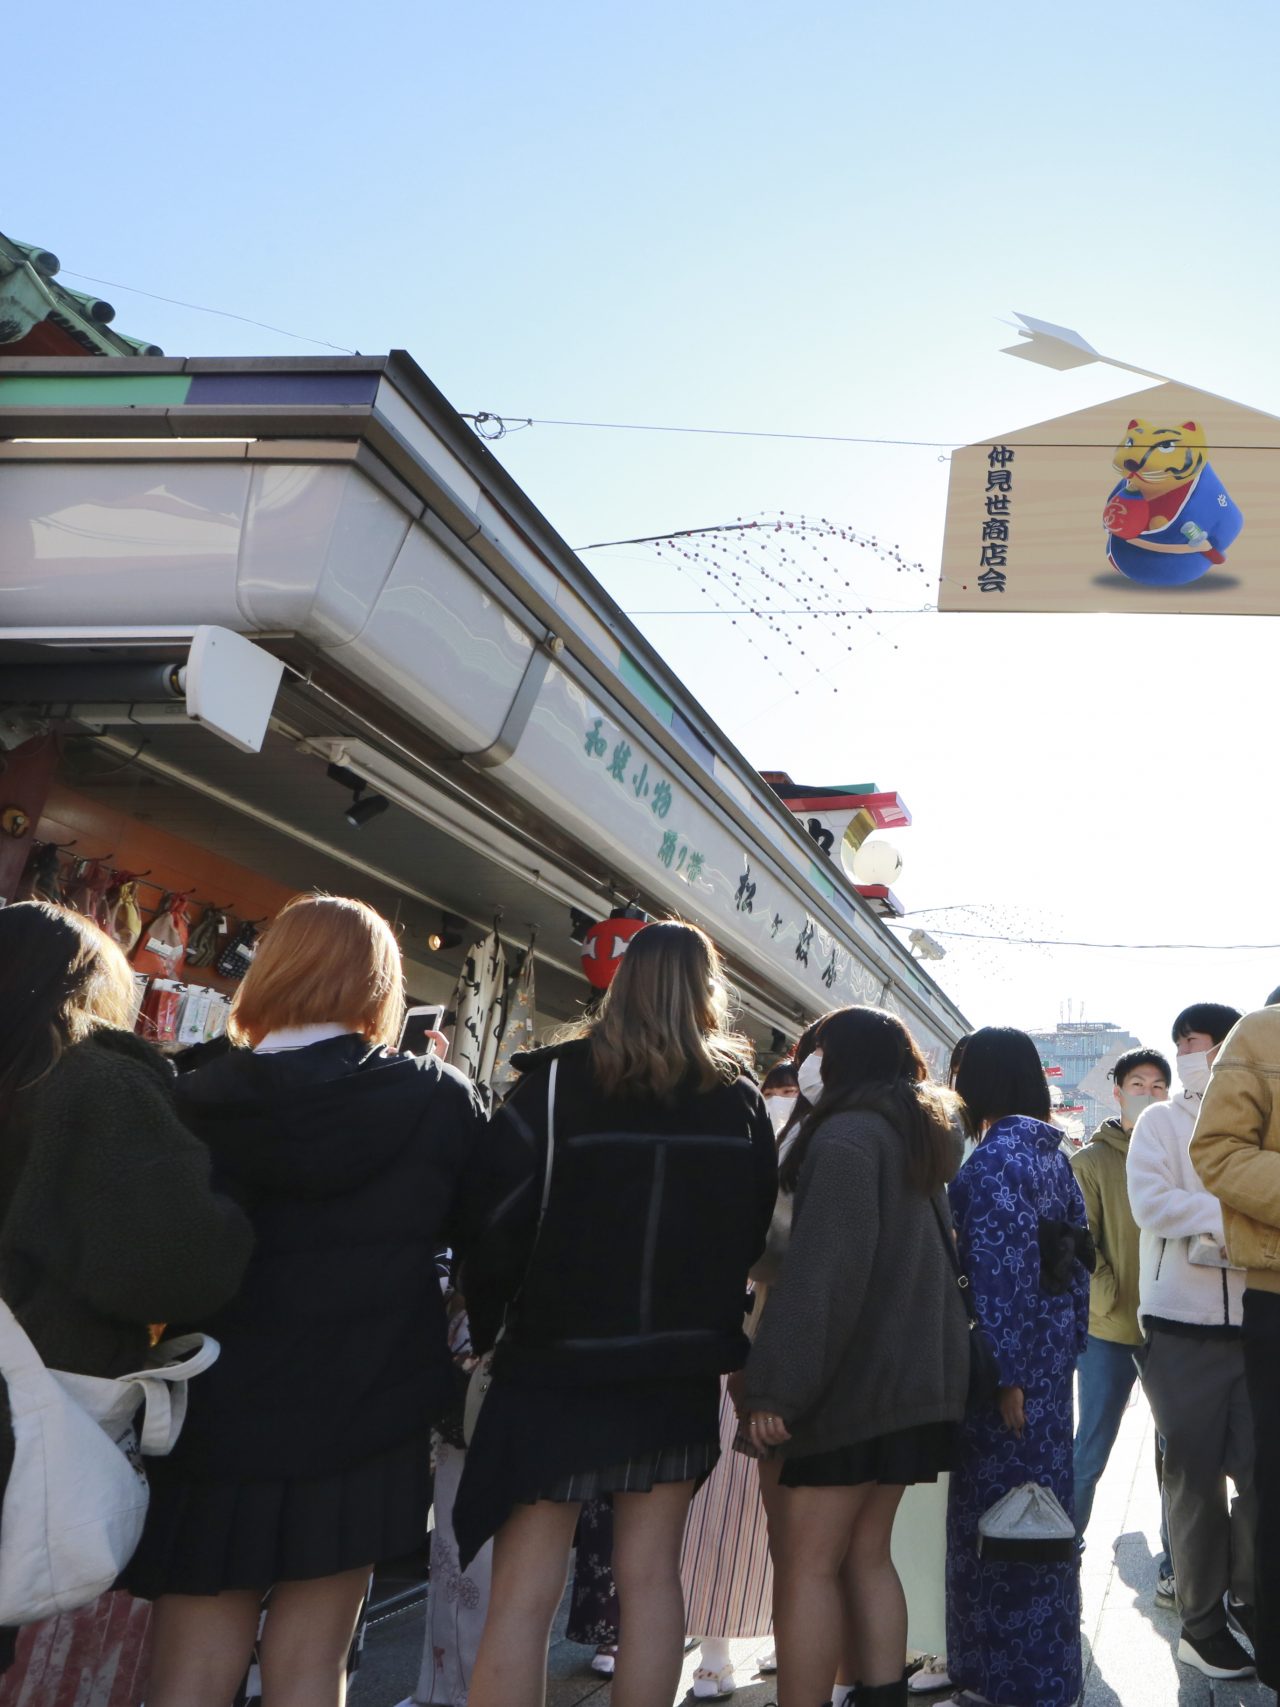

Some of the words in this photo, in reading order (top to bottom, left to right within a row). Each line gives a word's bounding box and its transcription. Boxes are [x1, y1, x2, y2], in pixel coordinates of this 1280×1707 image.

[978, 445, 1014, 593] 仲見世商店会
[584, 717, 673, 818] 和装小物
